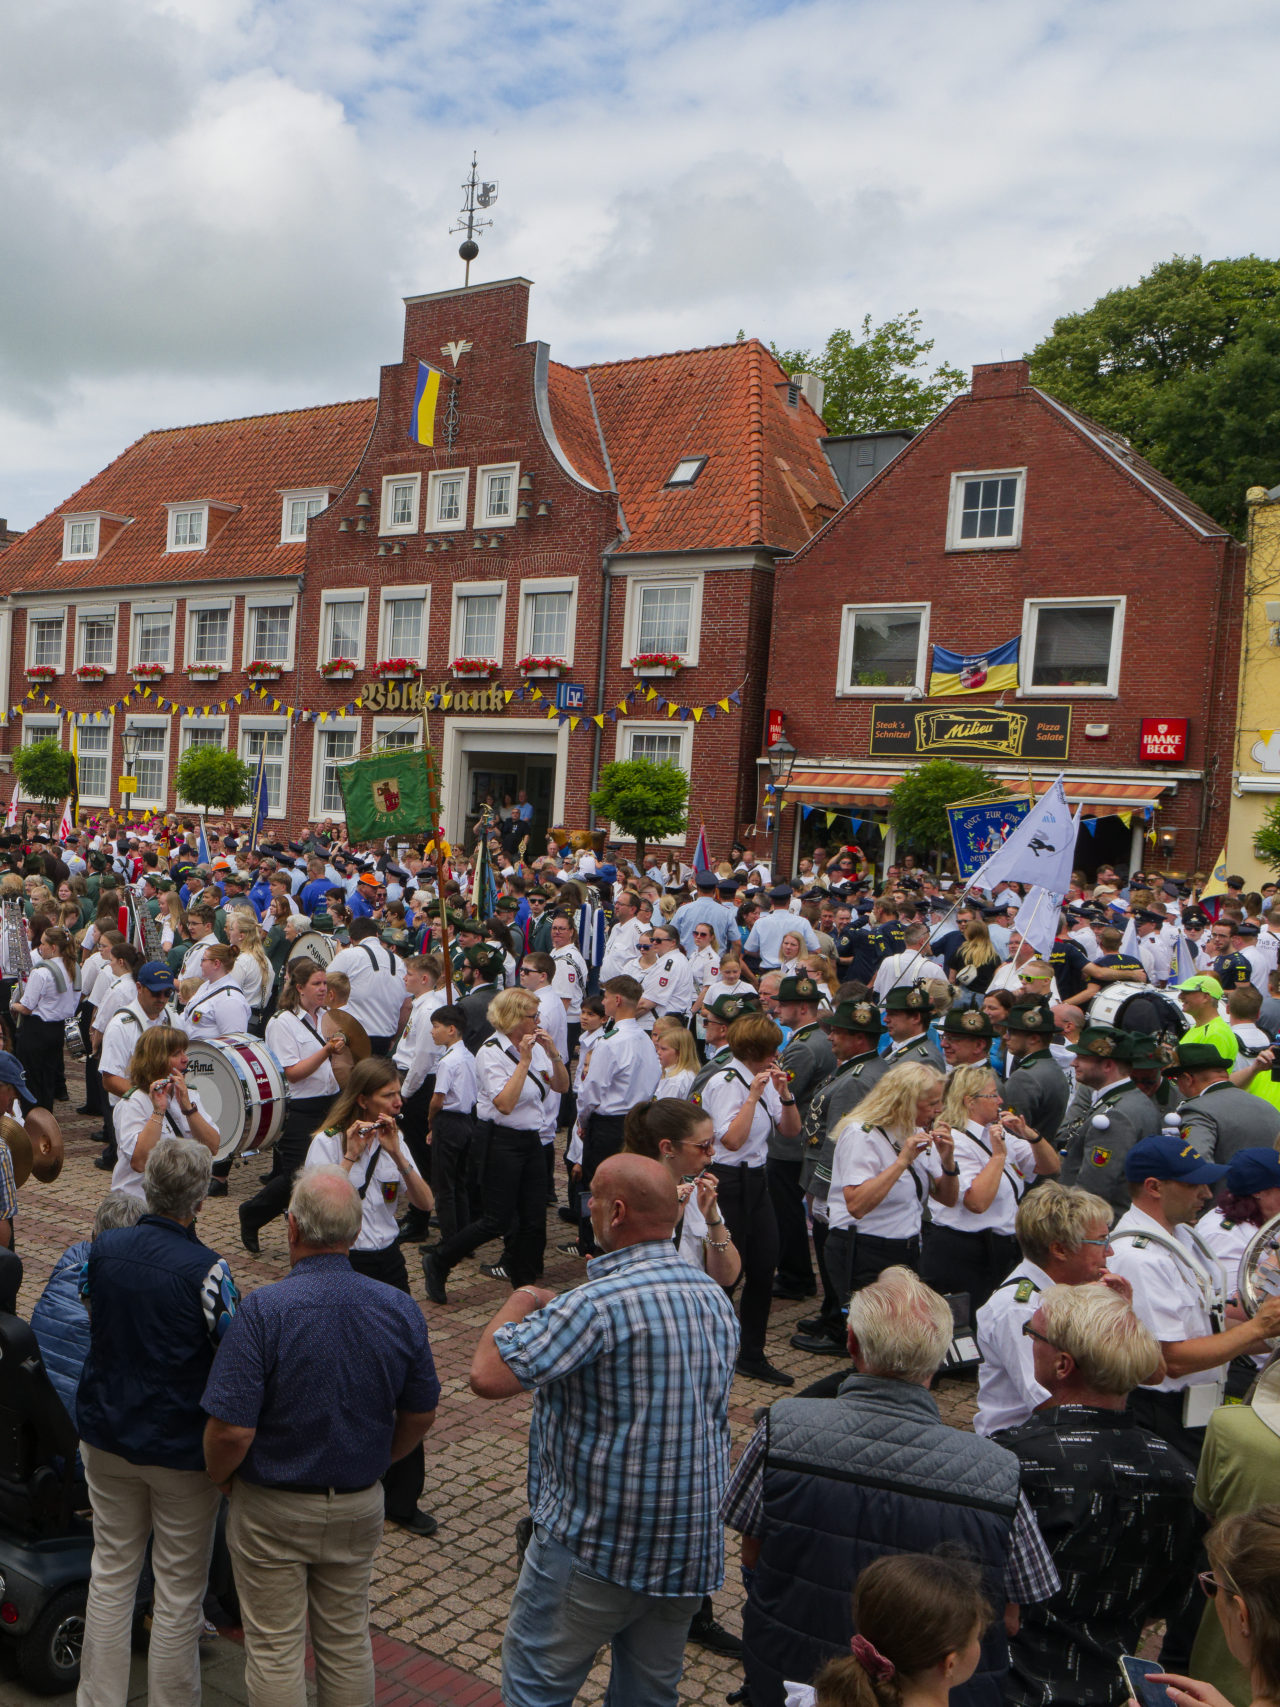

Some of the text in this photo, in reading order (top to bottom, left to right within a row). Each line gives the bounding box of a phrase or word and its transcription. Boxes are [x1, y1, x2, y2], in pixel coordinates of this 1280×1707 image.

[944, 721, 994, 739] Milieu
[1036, 722, 1061, 731] Pizza
[875, 730, 912, 739] Schnitzel
[1036, 732, 1065, 741] Salate
[1143, 734, 1182, 744] HAAKE
[1146, 744, 1176, 754] BECK
